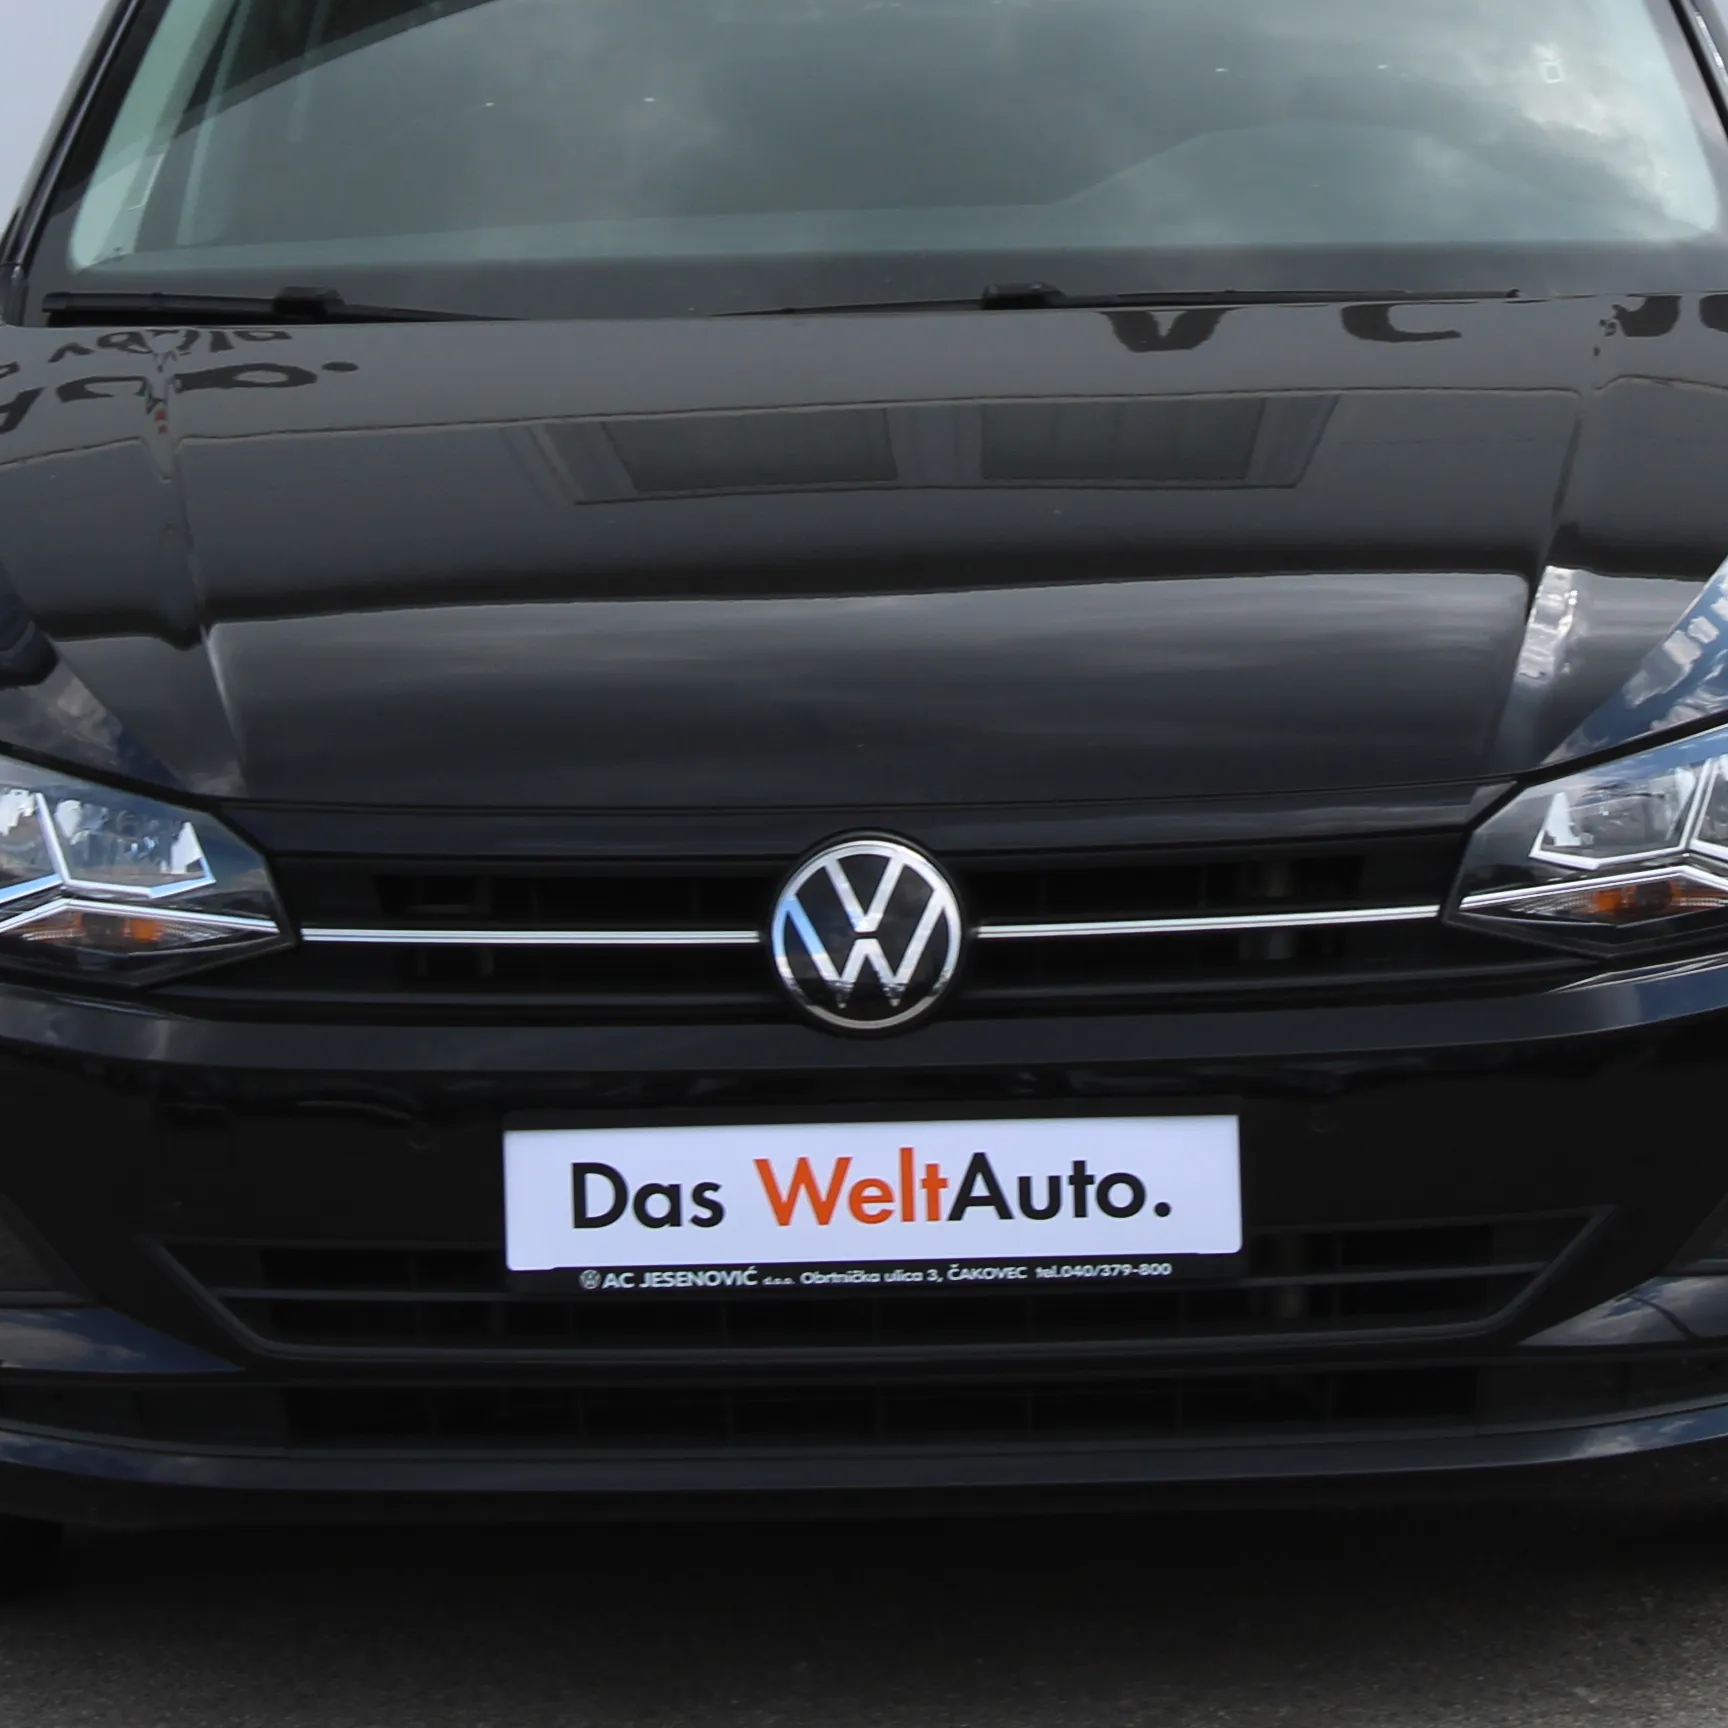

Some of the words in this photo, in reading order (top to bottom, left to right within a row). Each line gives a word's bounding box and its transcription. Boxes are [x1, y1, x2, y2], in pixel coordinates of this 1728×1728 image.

[571, 1161, 726, 1230] Das
[754, 1147, 1172, 1227] WeltAuto.
[602, 1272, 635, 1289] AC
[638, 1266, 758, 1289] JESENOVIĆ
[799, 1269, 881, 1284] Obrtnička
[884, 1270, 924, 1282] ulica
[947, 1263, 1028, 1281] ČAKOVEC
